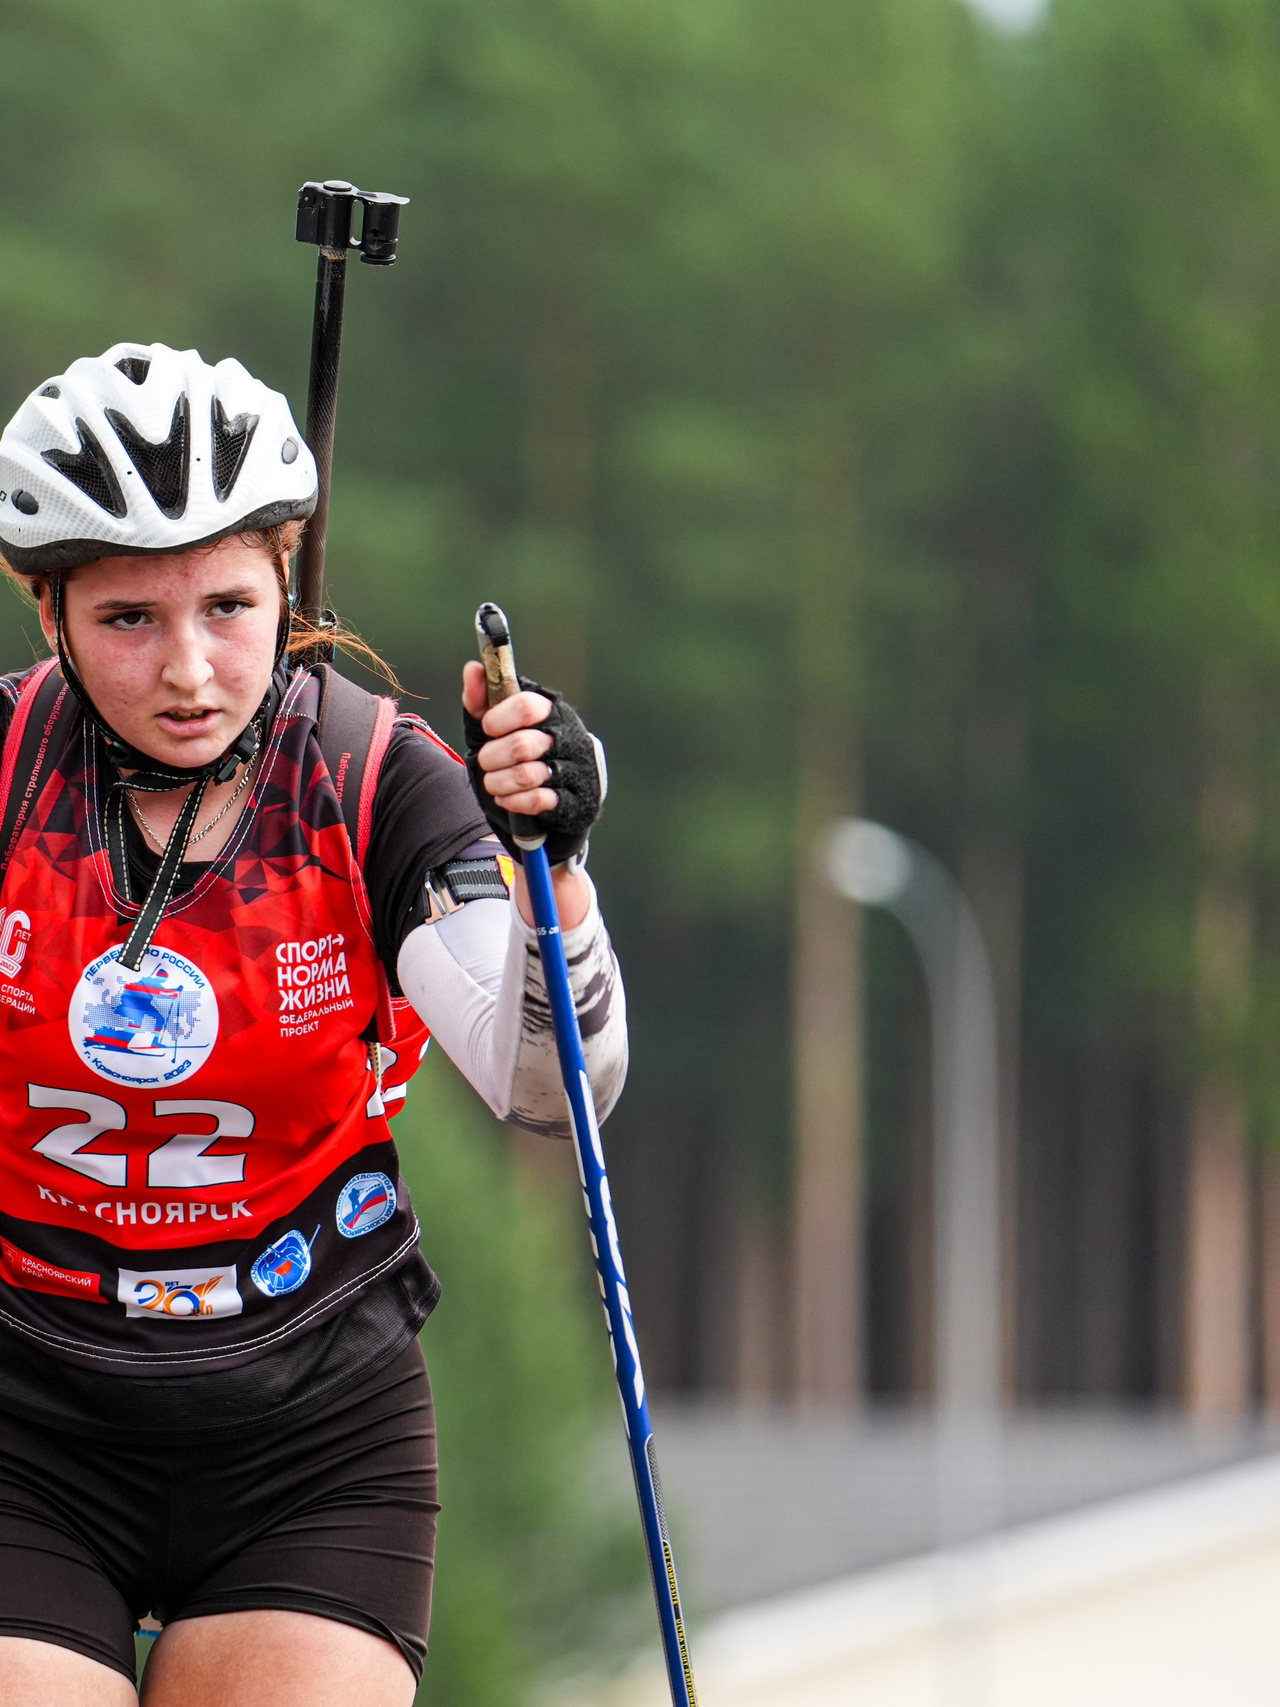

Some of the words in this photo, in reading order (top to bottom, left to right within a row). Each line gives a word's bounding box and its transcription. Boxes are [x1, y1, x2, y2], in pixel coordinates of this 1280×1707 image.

[25, 737, 49, 799] стрелкового
[14, 929, 32, 942] ЛЕТ
[275, 933, 332, 964] СПОРТ
[162, 952, 205, 988] РОССИИ
[277, 952, 347, 987] НОРМА
[1, 984, 34, 1003] СПОРТА
[278, 974, 351, 1011] ЖИЗНИ
[279, 996, 354, 1024] ФЕДЕРАЛЬНЫЙ
[280, 1020, 320, 1037] ПРОЕКТ
[92, 1058, 159, 1084] Красноярск
[163, 1059, 192, 1080] 2023
[27, 1081, 256, 1189] 22
[37, 1184, 253, 1225] КСНОЯРСК
[338, 1216, 387, 1237] КРАСОЯРСКОГО
[22, 1256, 92, 1287] КРАСНОЯРСКИЙ
[666, 1560, 678, 1605] COMPOSITE
[676, 1618, 685, 1643] ULTRA
[680, 1643, 689, 1667] LIGHT
